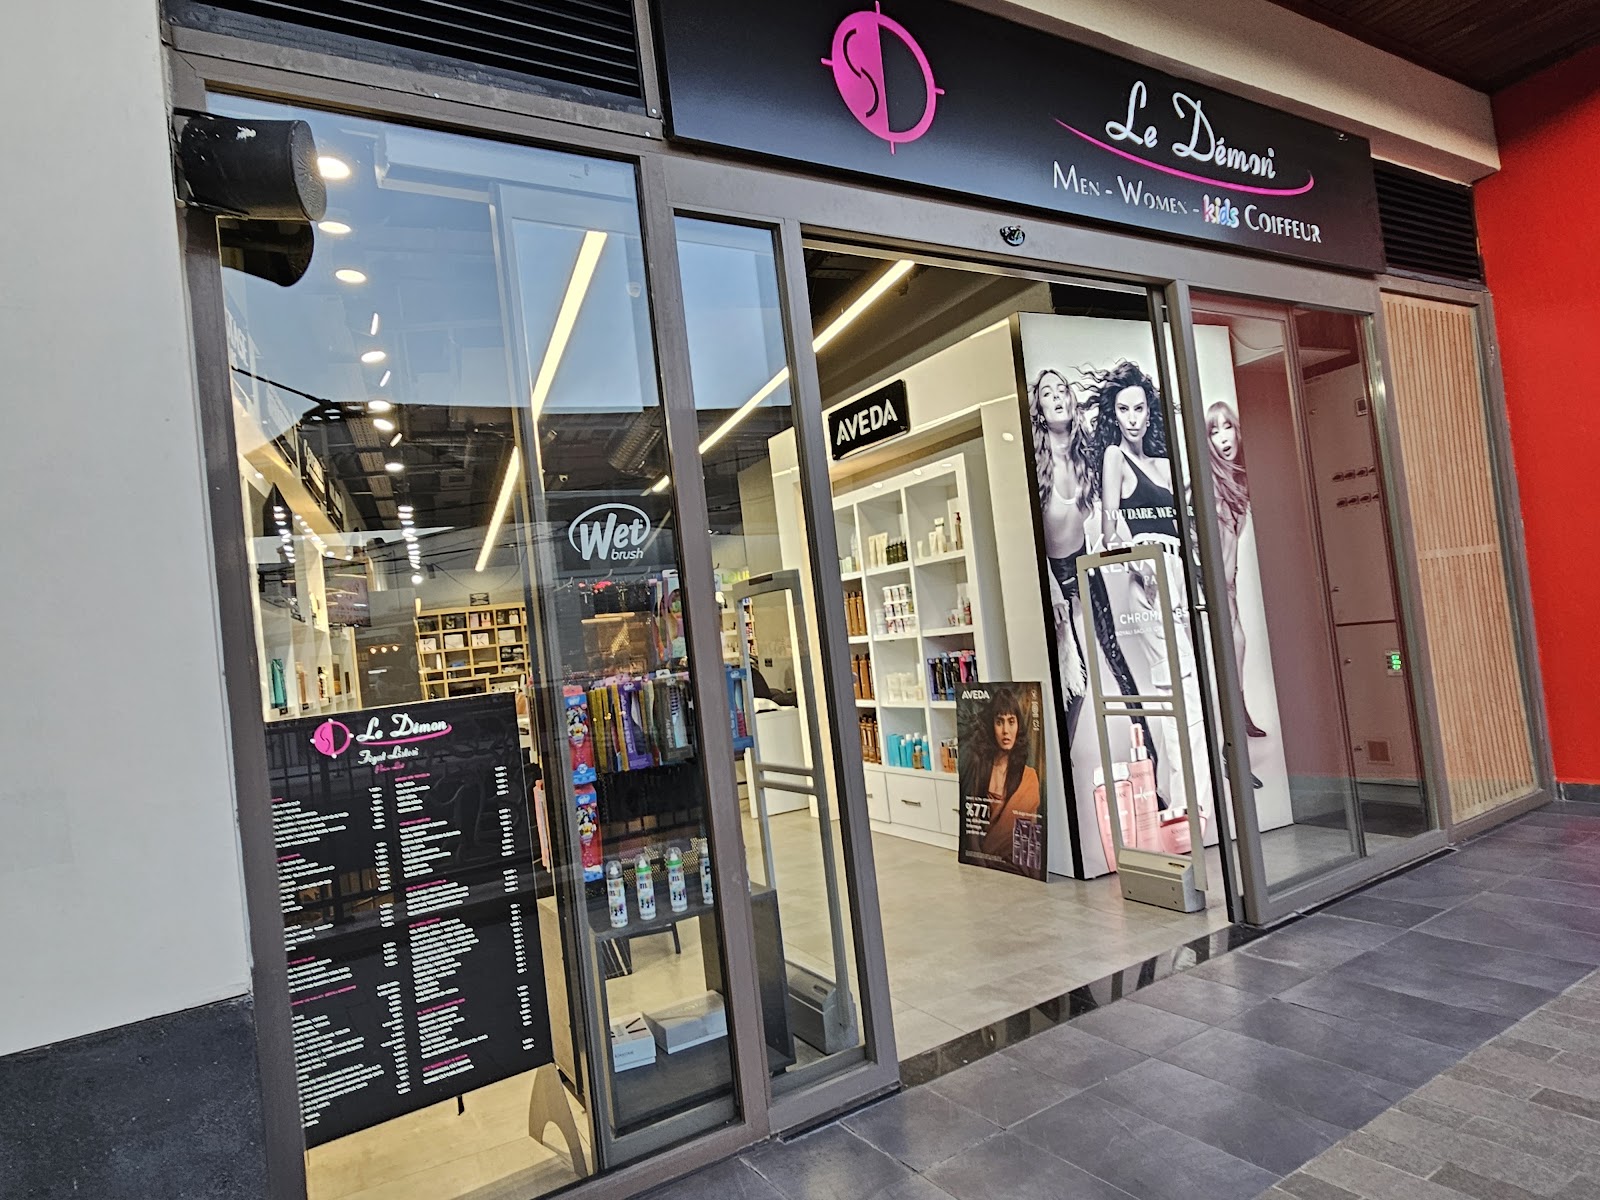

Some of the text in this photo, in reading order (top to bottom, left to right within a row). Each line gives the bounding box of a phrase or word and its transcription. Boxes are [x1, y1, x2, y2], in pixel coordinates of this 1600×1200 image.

[1105, 80, 1276, 179] Le Démon
[1203, 194, 1241, 229] kids
[836, 398, 898, 446] AVEDA
[1104, 509, 1126, 520] YOU
[1127, 507, 1157, 520] DARE,
[1157, 506, 1173, 518] WE
[580, 512, 644, 560] Wet
[611, 547, 644, 560] brush
[962, 690, 990, 700] AVEDA
